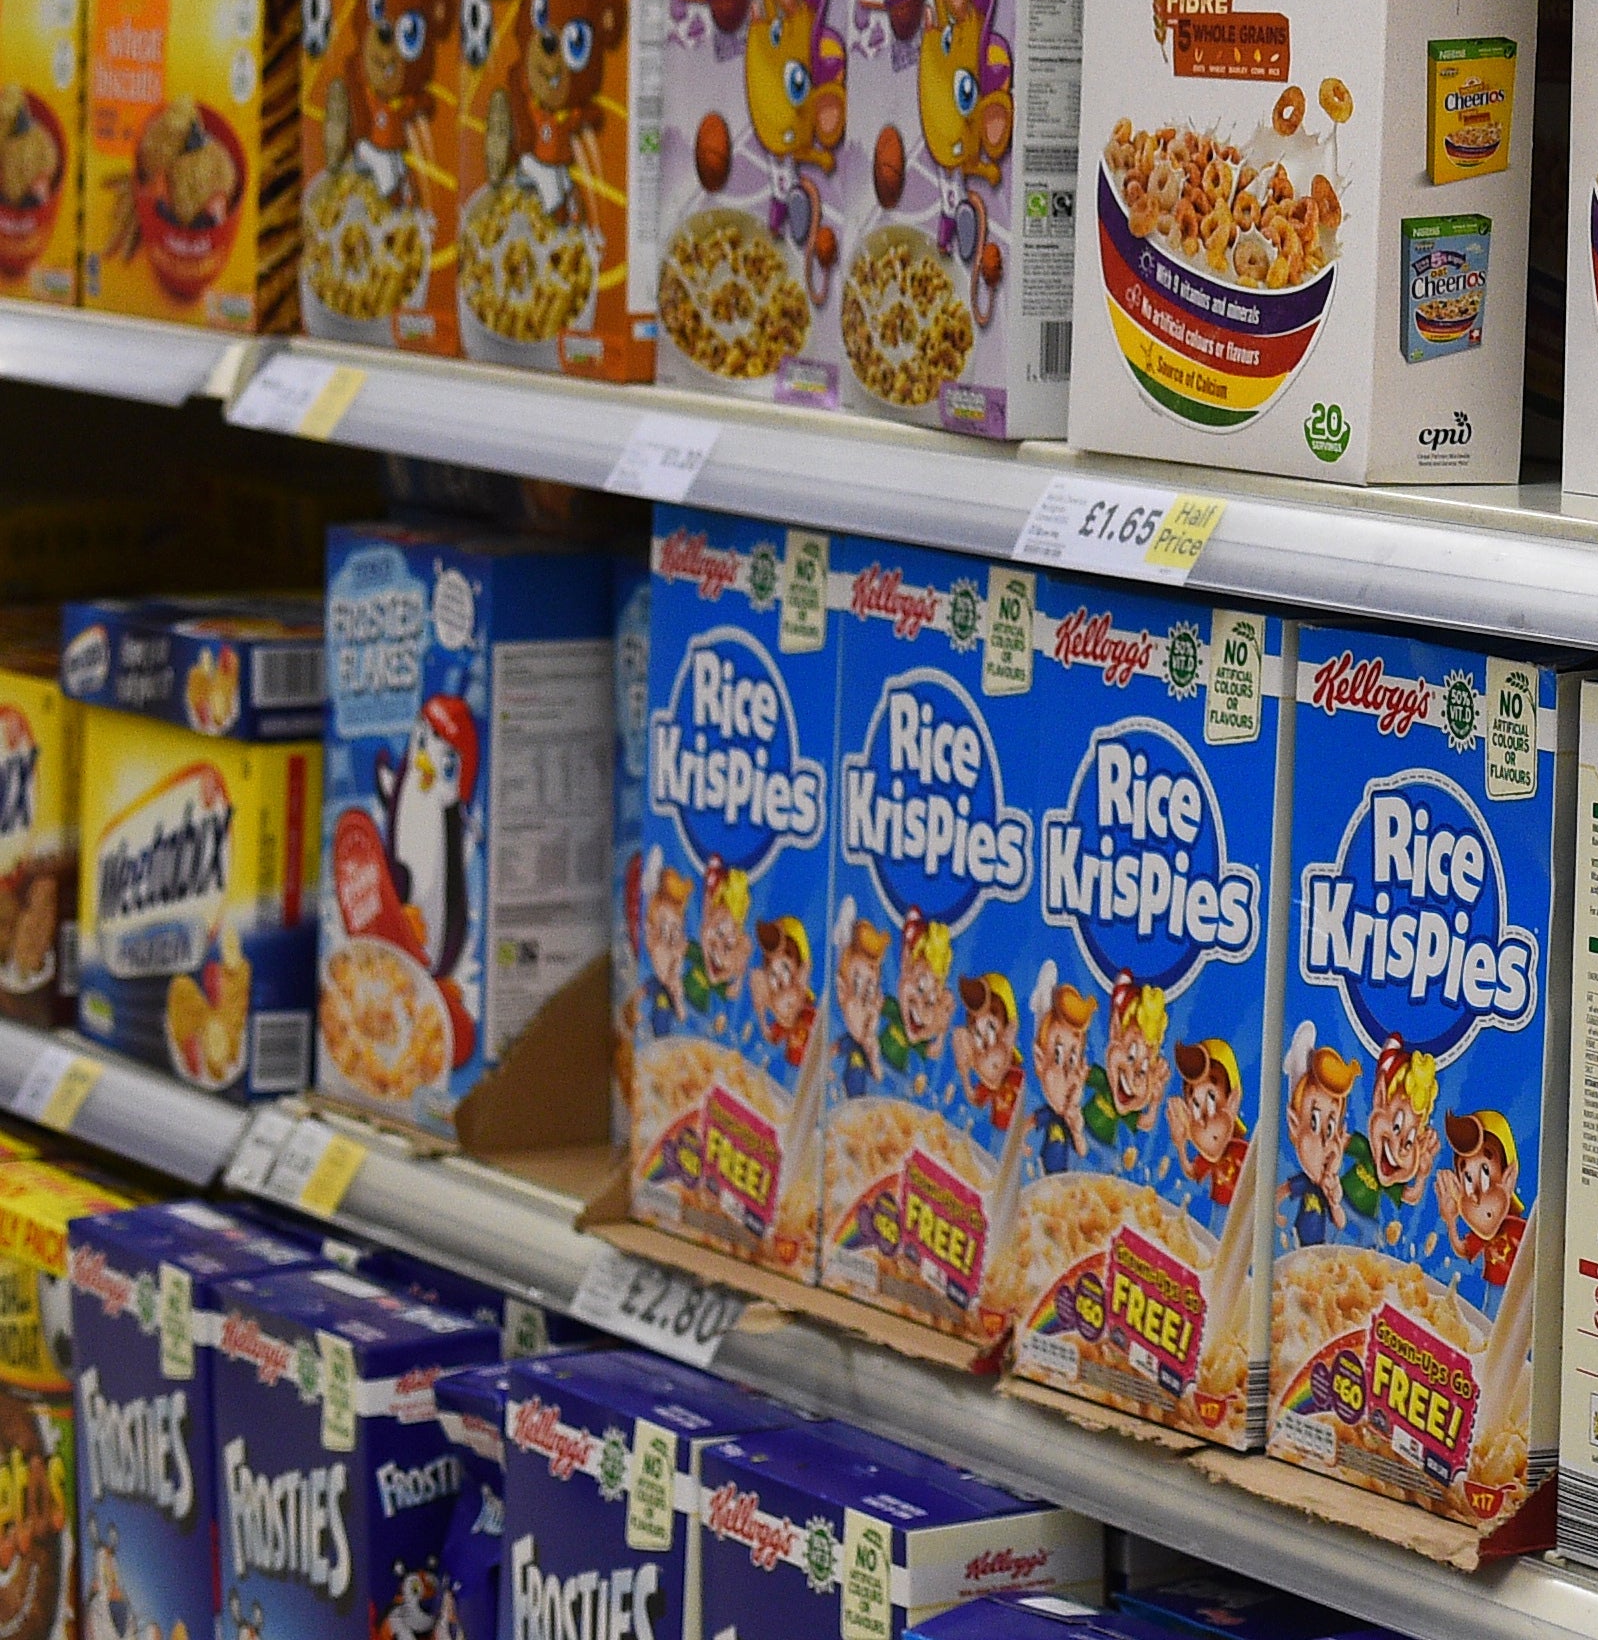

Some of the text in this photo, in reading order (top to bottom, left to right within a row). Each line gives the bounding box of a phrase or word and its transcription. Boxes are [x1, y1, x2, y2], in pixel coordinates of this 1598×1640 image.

[1444, 88, 1505, 113] Cheerios
[1411, 268, 1486, 301] Cheerios
[1311, 402, 1343, 439] 20
[1078, 500, 1162, 546] £1.65
[1174, 501, 1217, 527] Half
[1154, 528, 1205, 557] Price
[1313, 650, 1430, 737] Kellogg's
[1499, 689, 1523, 720] NO
[1492, 733, 1530, 754] COLOURS
[1493, 718, 1531, 737] ARTIFICIAL
[1489, 764, 1532, 787] FLAVOURS
[1504, 751, 1517, 767] OR
[1098, 743, 1202, 846] Rice
[1372, 796, 1486, 906] Rice
[1049, 826, 1253, 945] Krispies
[1310, 881, 1529, 1013] Krispies
[1371, 1351, 1465, 1448] FREE!
[224, 1436, 352, 1600] FROSTIES
